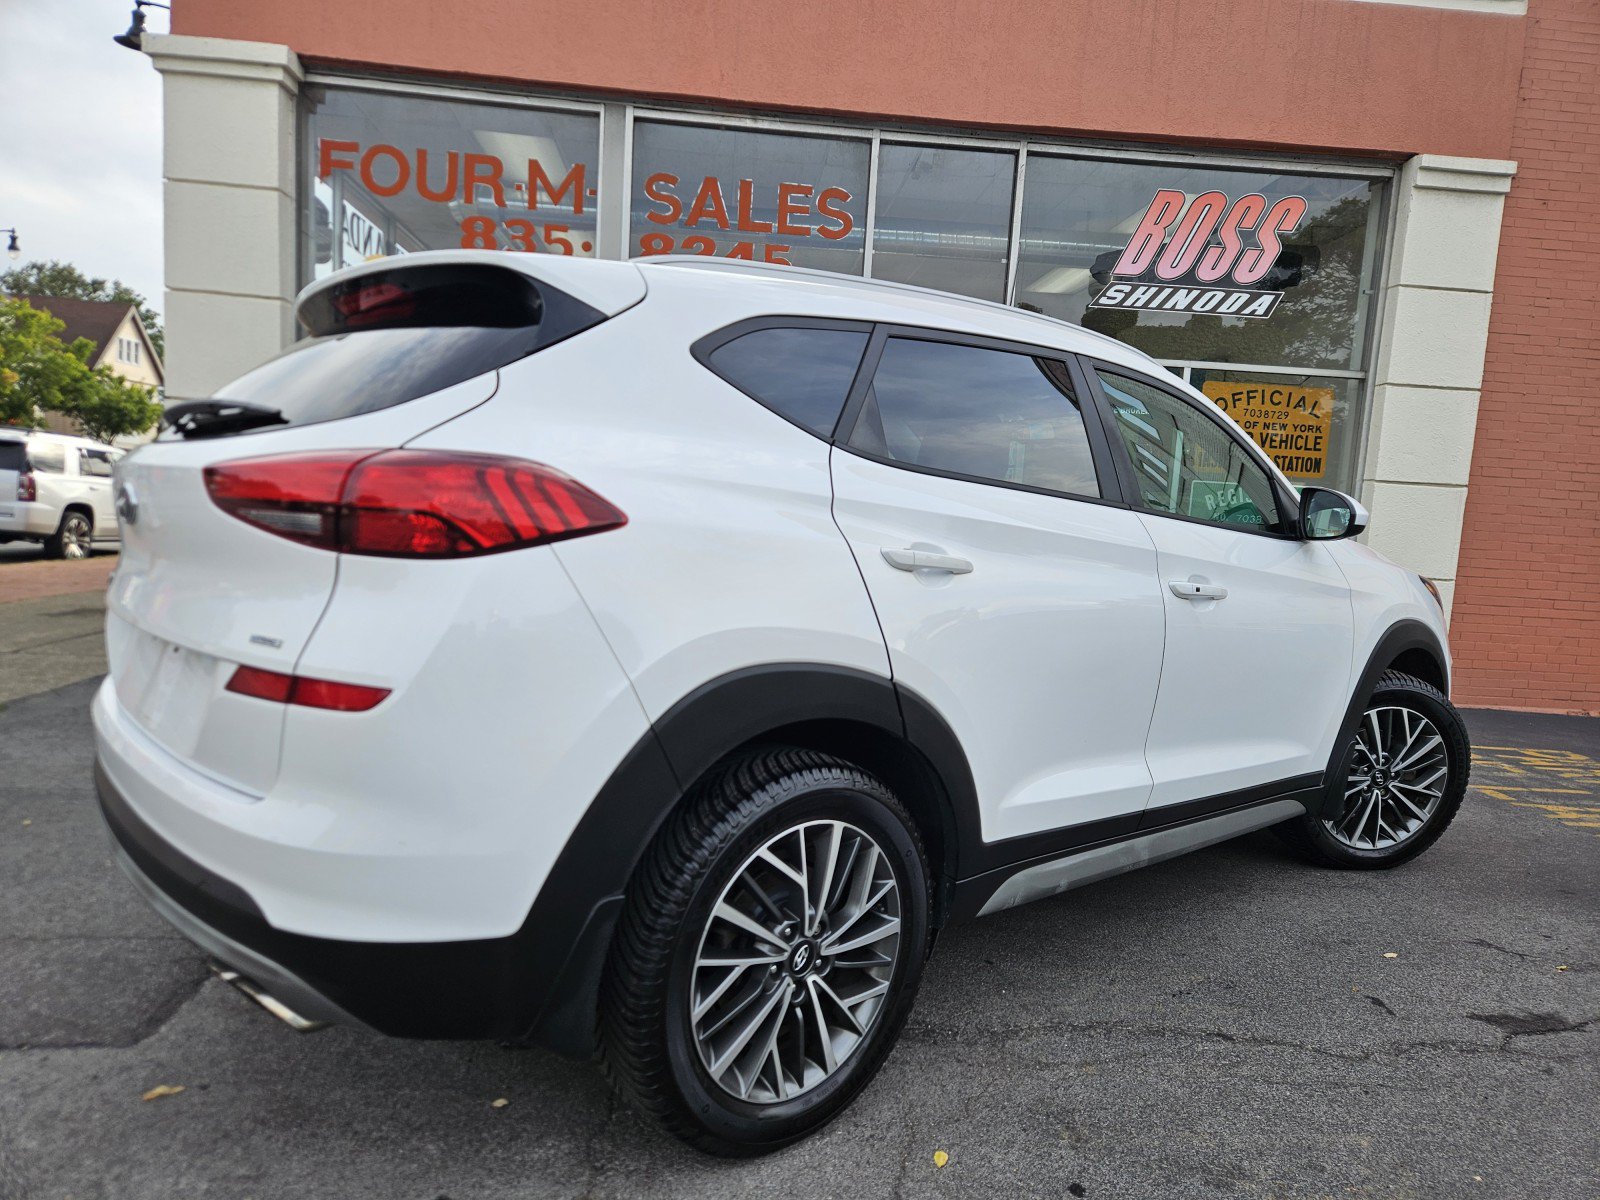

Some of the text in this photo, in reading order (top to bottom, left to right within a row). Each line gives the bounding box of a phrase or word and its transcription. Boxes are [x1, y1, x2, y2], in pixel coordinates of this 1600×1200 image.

[645, 172, 854, 241] SALES
[1111, 188, 1308, 285] BOSS
[1098, 284, 1276, 316] SHINODA
[1215, 389, 1321, 419] OFFICIAL
[1243, 408, 1290, 420] 7038729
[1244, 421, 1259, 430] OF
[1263, 422, 1288, 431] NEW
[1292, 424, 1322, 434] YORK
[1260, 432, 1323, 451] VEHICLE
[1273, 456, 1322, 474] STATION
